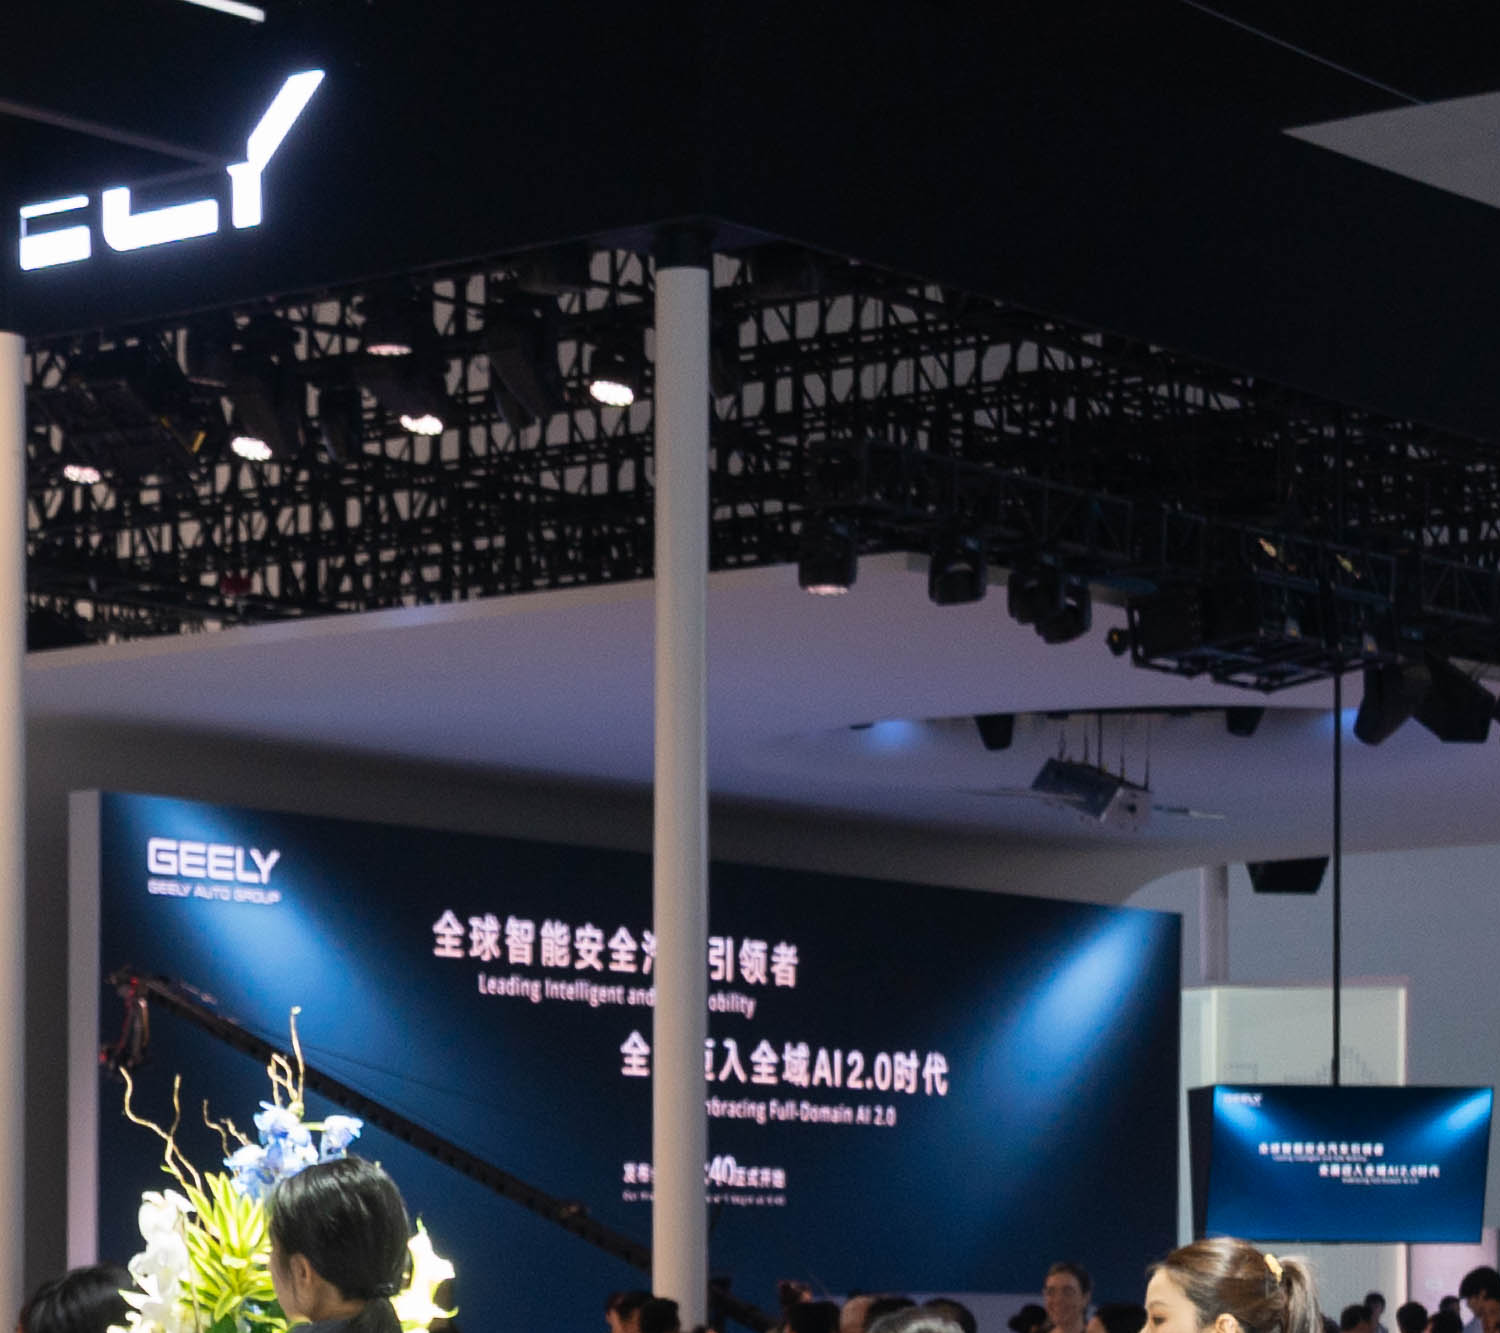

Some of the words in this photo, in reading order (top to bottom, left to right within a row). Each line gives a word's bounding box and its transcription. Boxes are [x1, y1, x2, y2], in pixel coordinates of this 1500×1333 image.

[147, 837, 281, 885] GEELY
[147, 877, 193, 897] GEELY
[193, 882, 231, 900] AUTO
[233, 886, 281, 904] GROUP
[432, 908, 800, 988] 全球智能安全引领者
[478, 972, 542, 1004] Leading
[545, 978, 624, 1008] Intelligent
[626, 985, 656, 1008] and
[707, 991, 757, 1020] obility
[769, 1098, 854, 1124] Full-Domain
[855, 1103, 873, 1125] AI
[874, 1104, 897, 1128] 2.0
